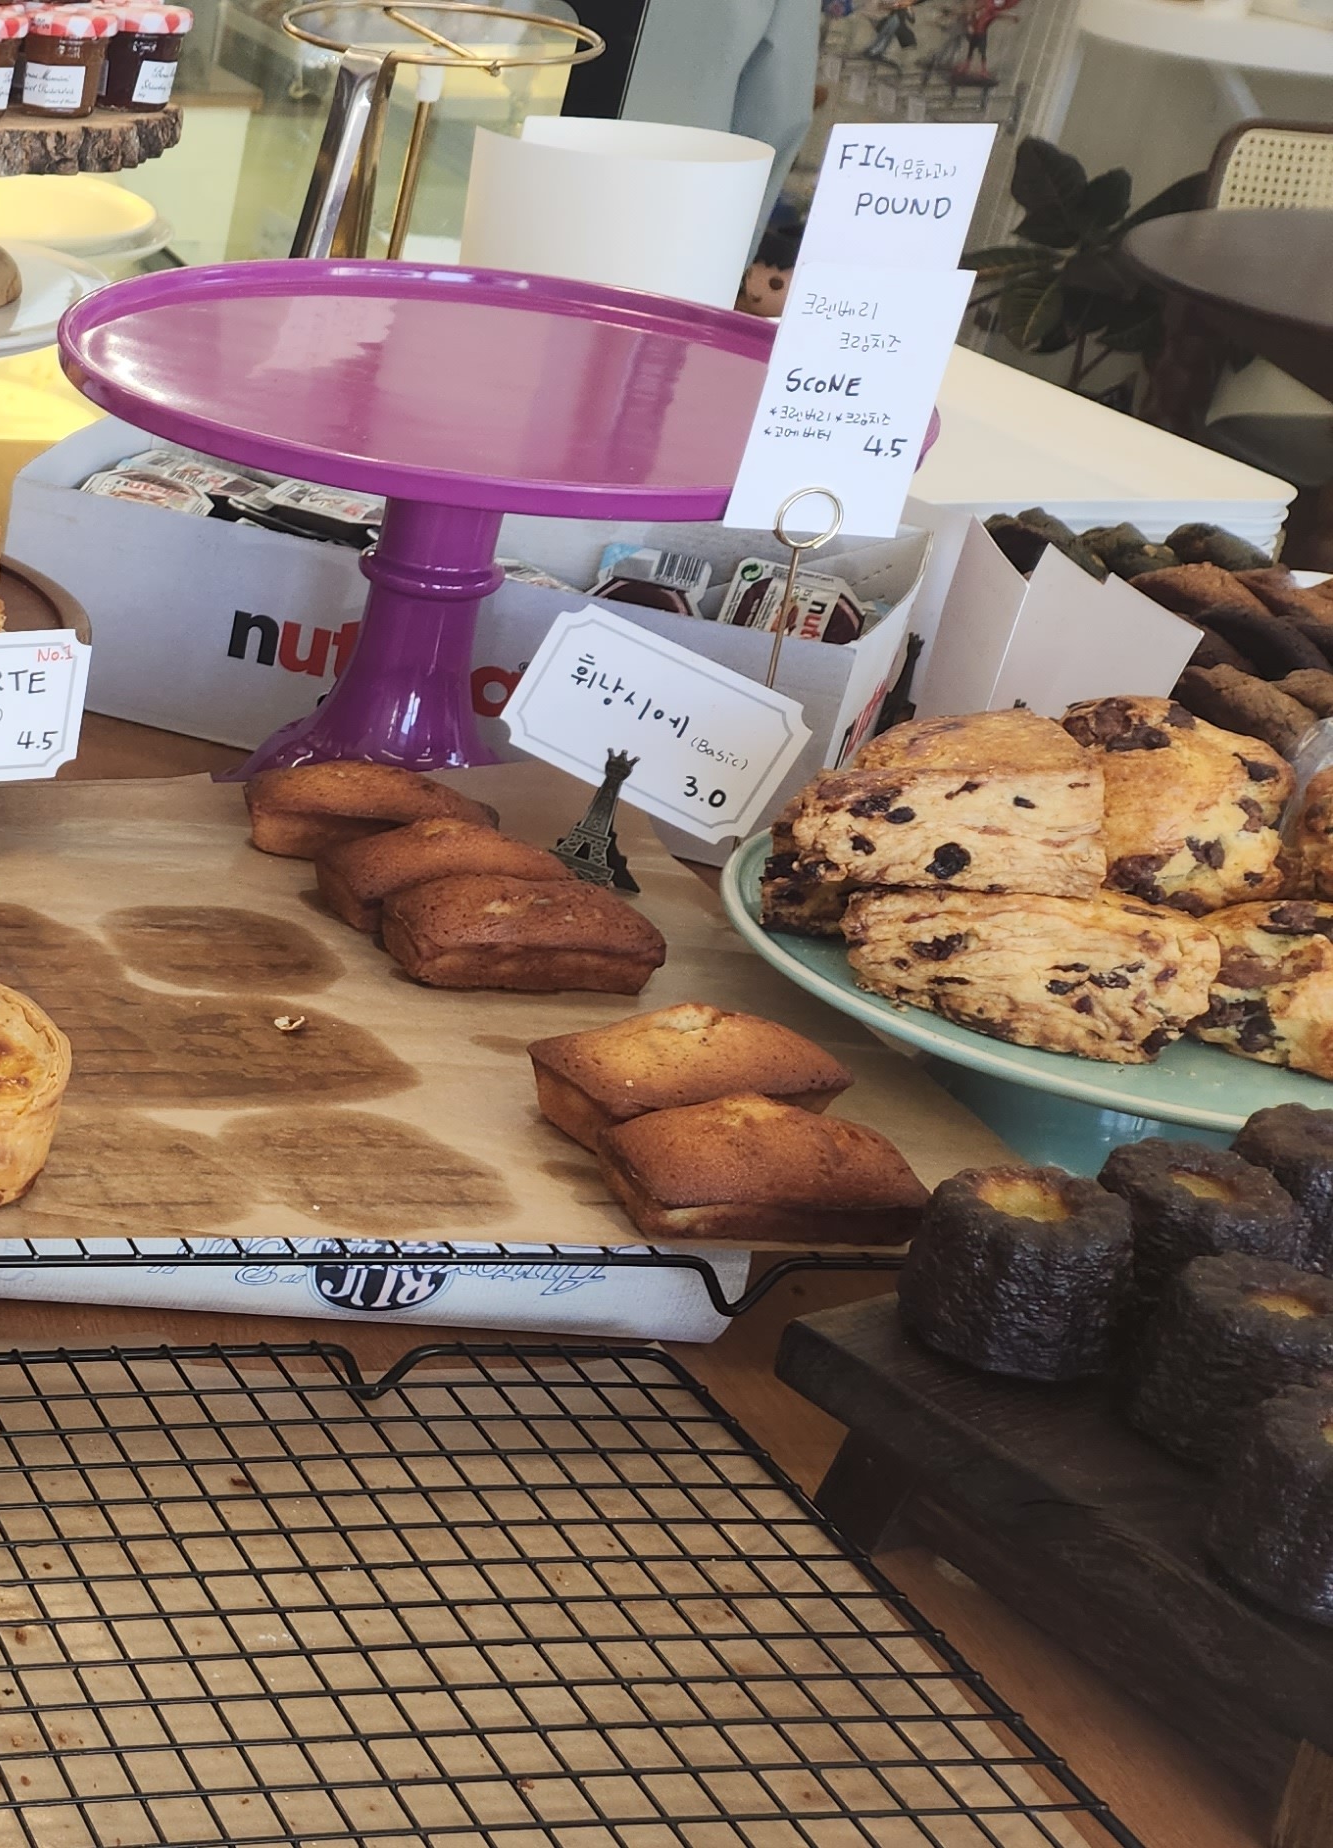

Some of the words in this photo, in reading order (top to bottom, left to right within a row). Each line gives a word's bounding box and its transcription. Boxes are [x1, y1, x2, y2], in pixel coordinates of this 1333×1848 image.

[838, 143, 894, 170] FIG
[853, 193, 952, 220] POUND
[839, 331, 902, 353] 크림치즈
[844, 412, 891, 426] 크림치즈
[862, 435, 908, 458] 4.5
[36, 644, 75, 663] No.1
[16, 730, 59, 750] 4.5
[682, 775, 727, 808] 3.0
